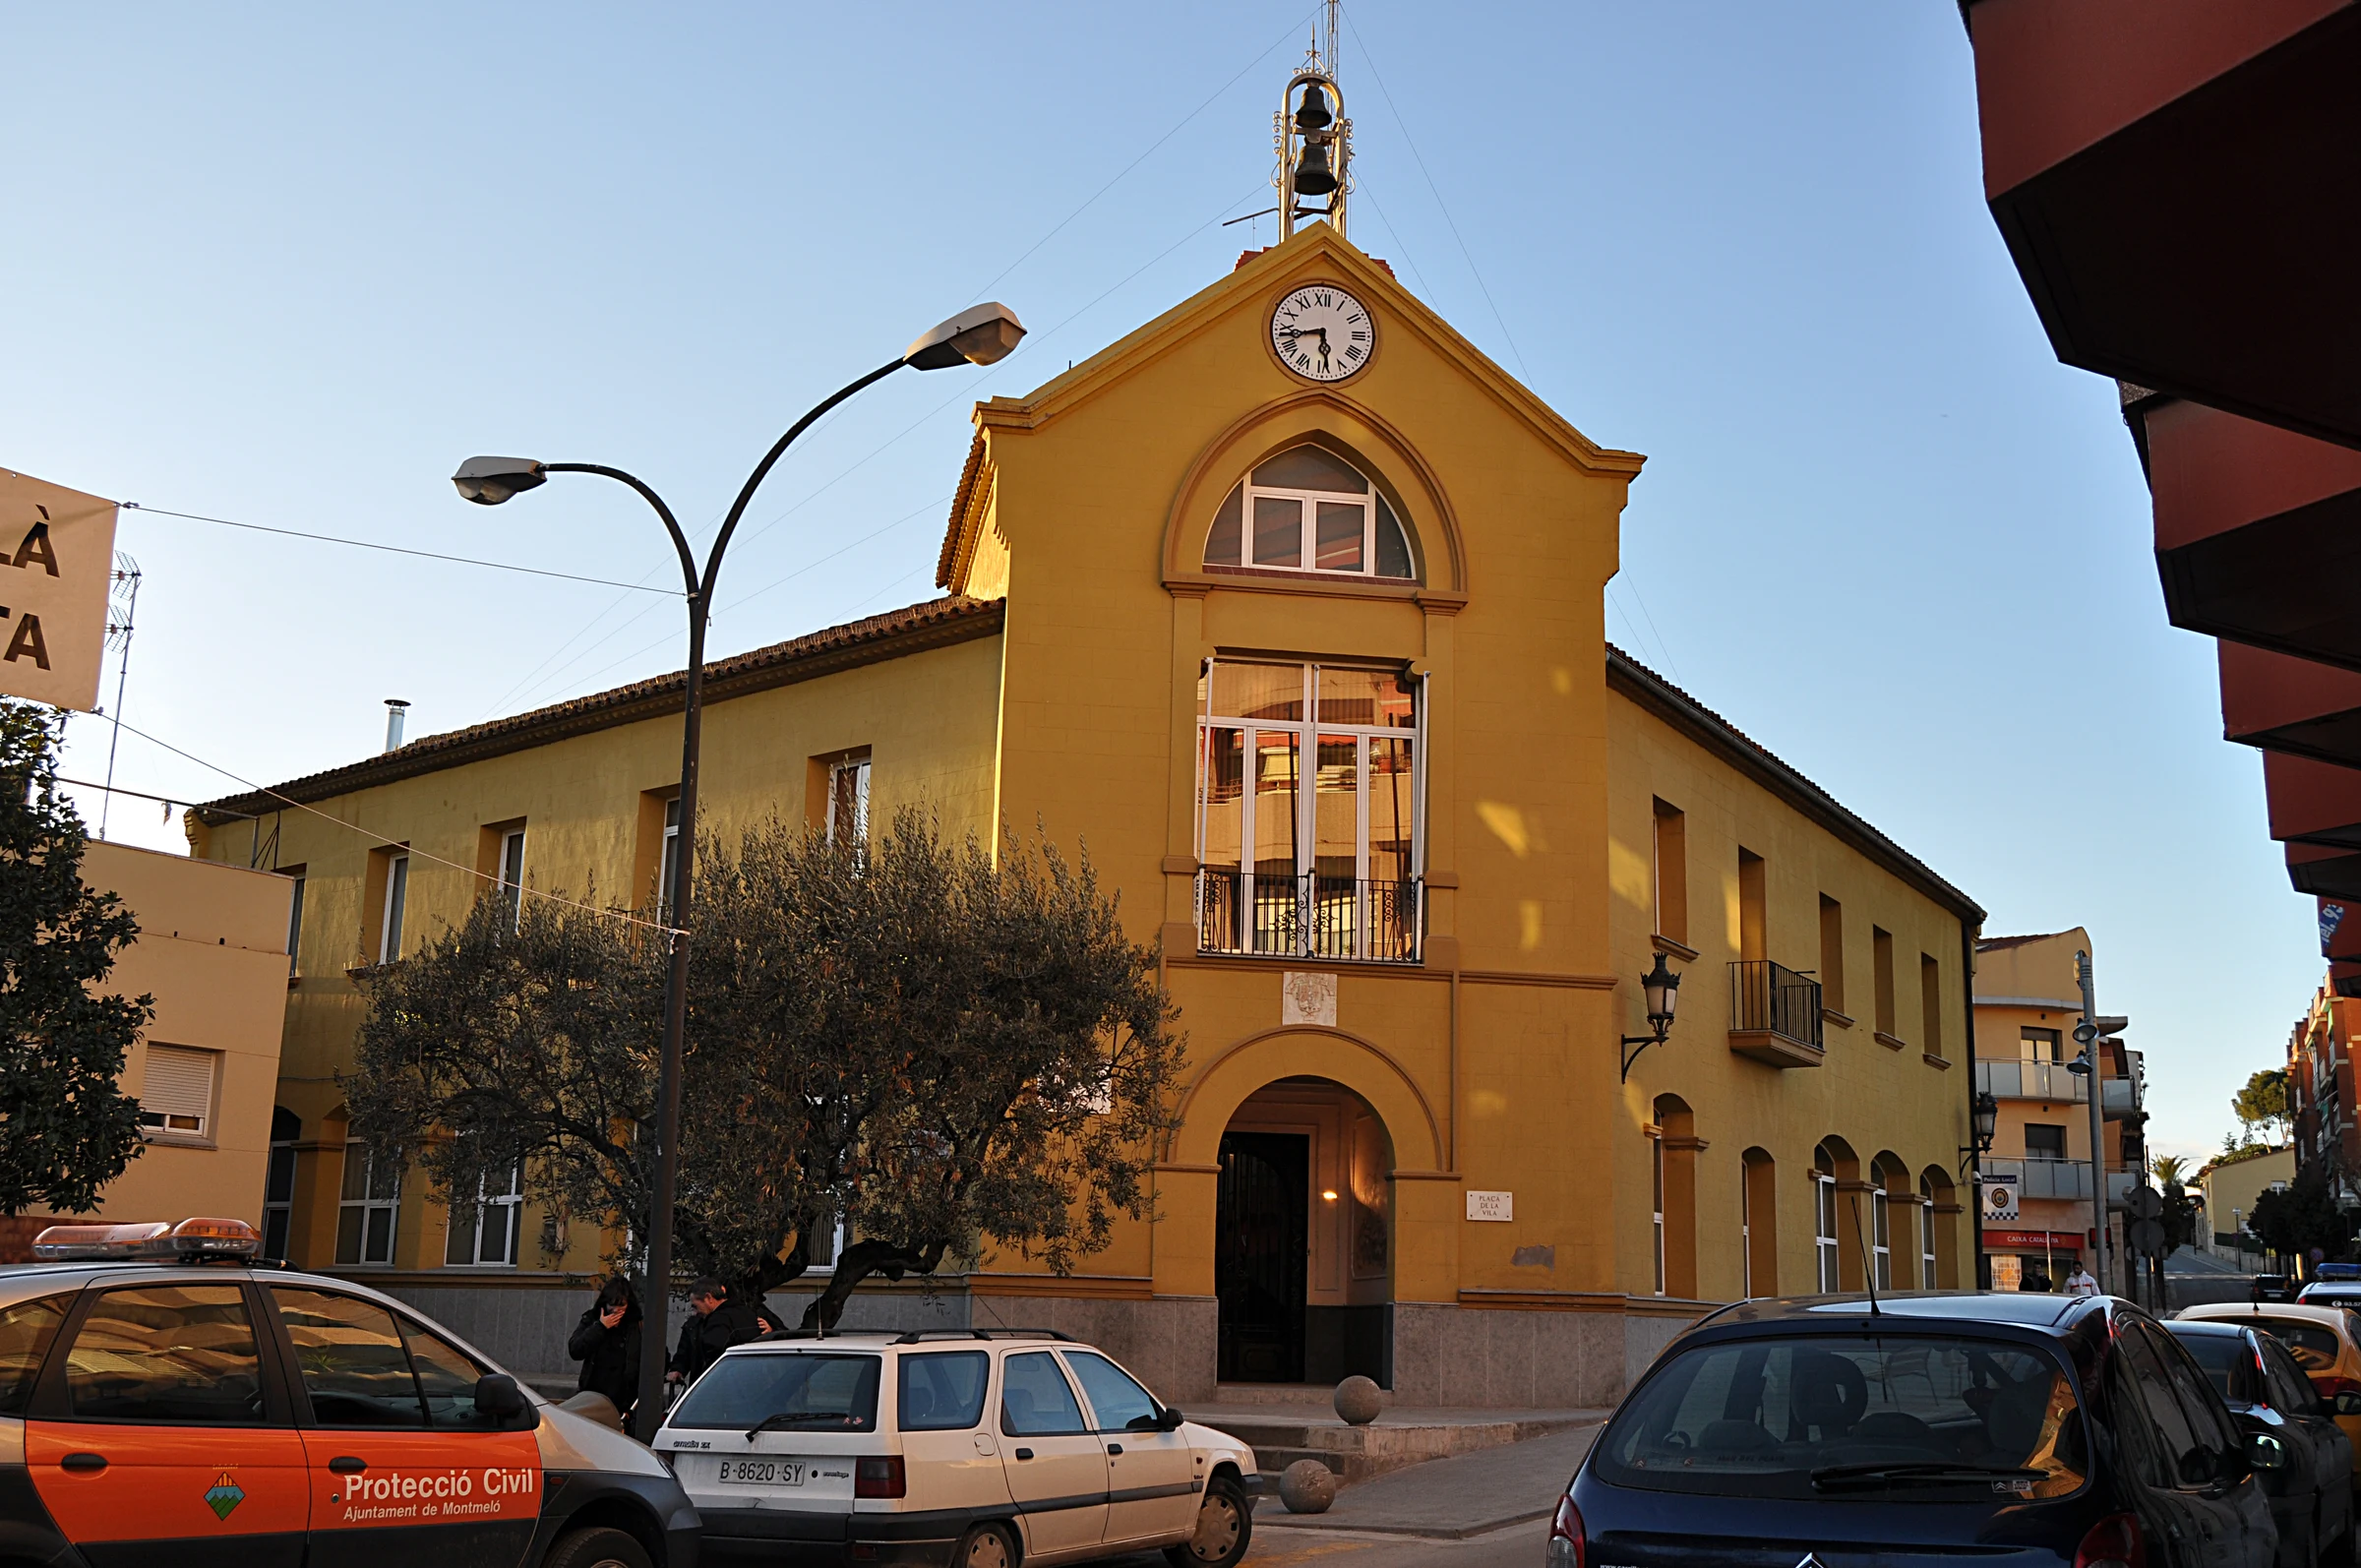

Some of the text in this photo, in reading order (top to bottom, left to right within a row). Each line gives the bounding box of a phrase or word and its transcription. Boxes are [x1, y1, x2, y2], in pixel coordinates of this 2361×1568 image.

[1295, 295, 1311, 312] XI
[1314, 292, 1331, 308] XII
[1283, 308, 1299, 322] X
[1346, 313, 1362, 325] II
[1351, 331, 1366, 341] III
[1281, 338, 1299, 359] VIII
[1296, 353, 1310, 370] VII
[0, 504, 60, 578] À
[344, 1467, 533, 1501] Protecció Civil
[343, 1500, 501, 1523] Ajuntament de Montmeló
